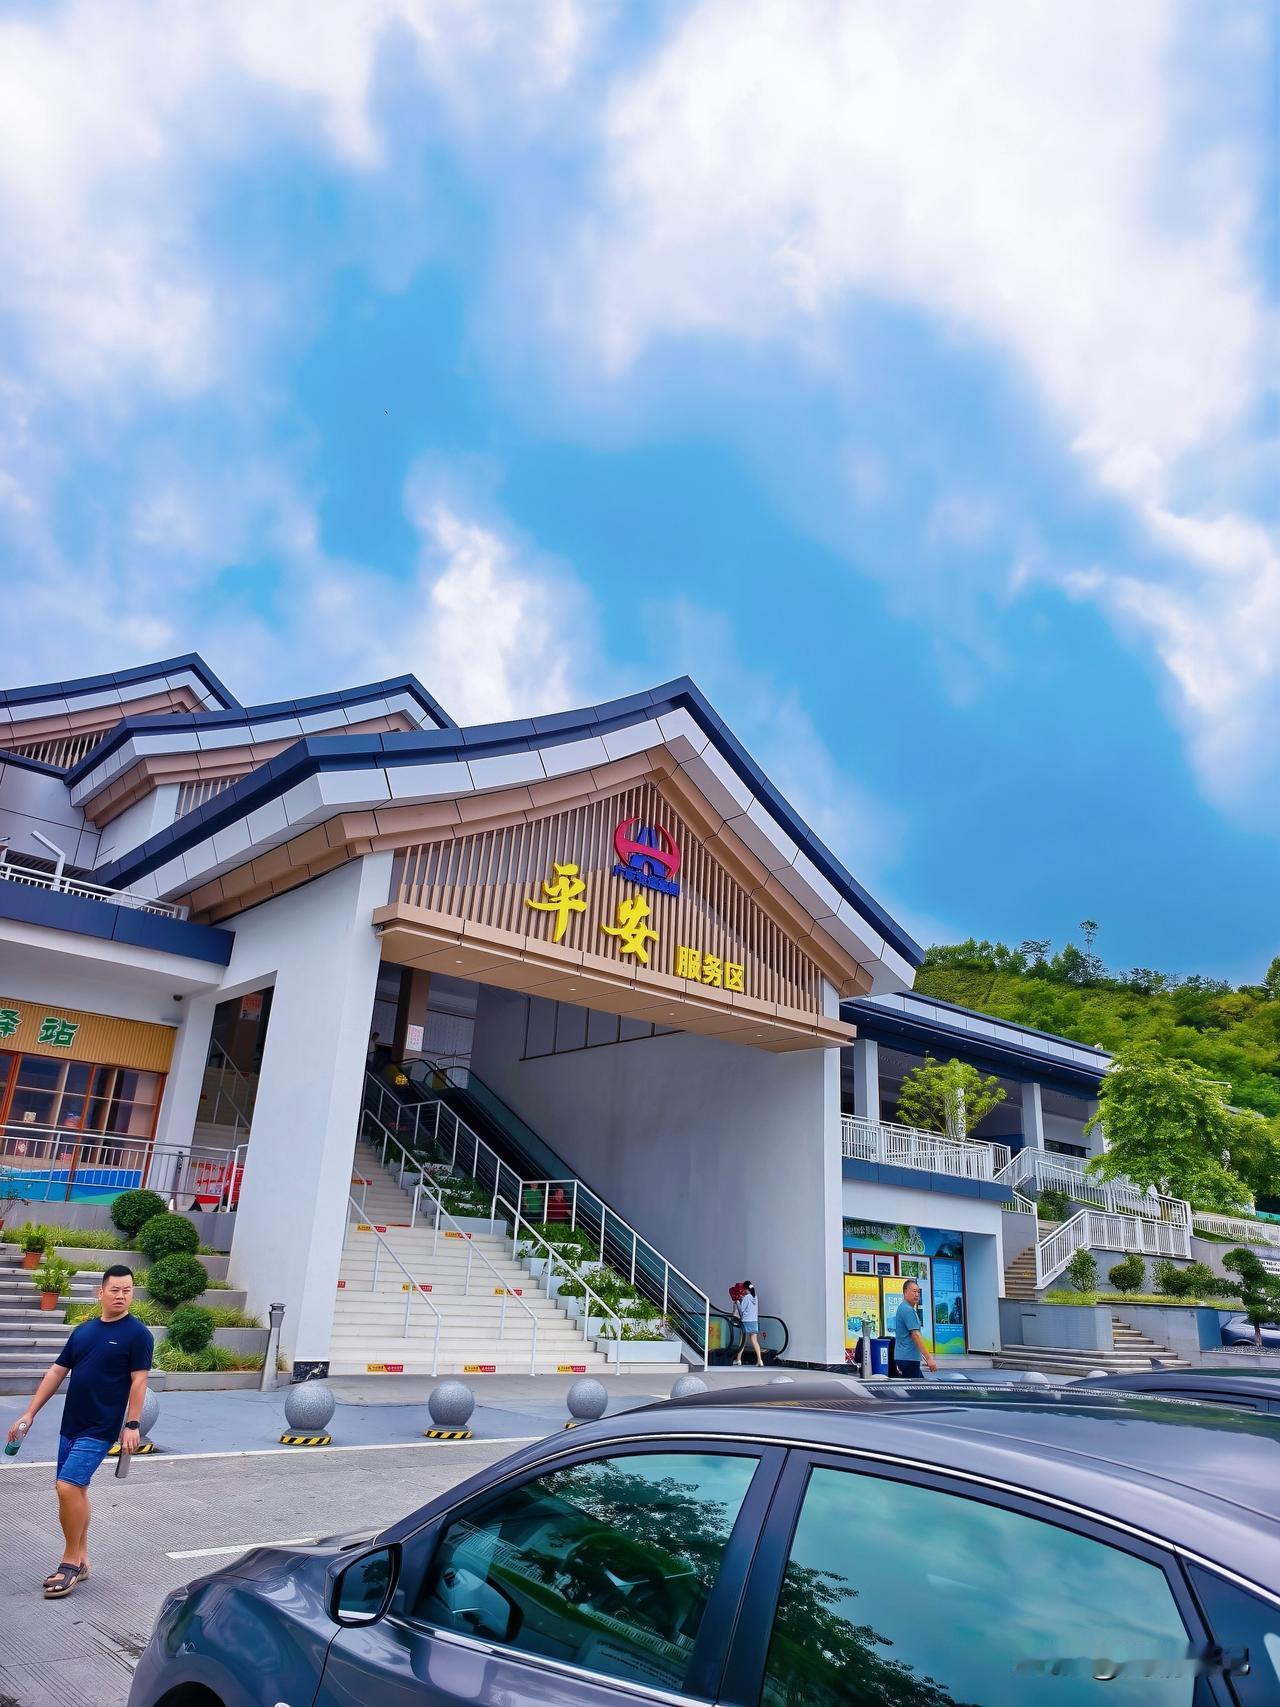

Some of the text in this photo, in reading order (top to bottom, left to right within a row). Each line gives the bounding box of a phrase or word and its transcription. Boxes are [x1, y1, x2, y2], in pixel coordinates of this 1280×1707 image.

[525, 862, 659, 964] 平安
[674, 945, 744, 992] 服务区
